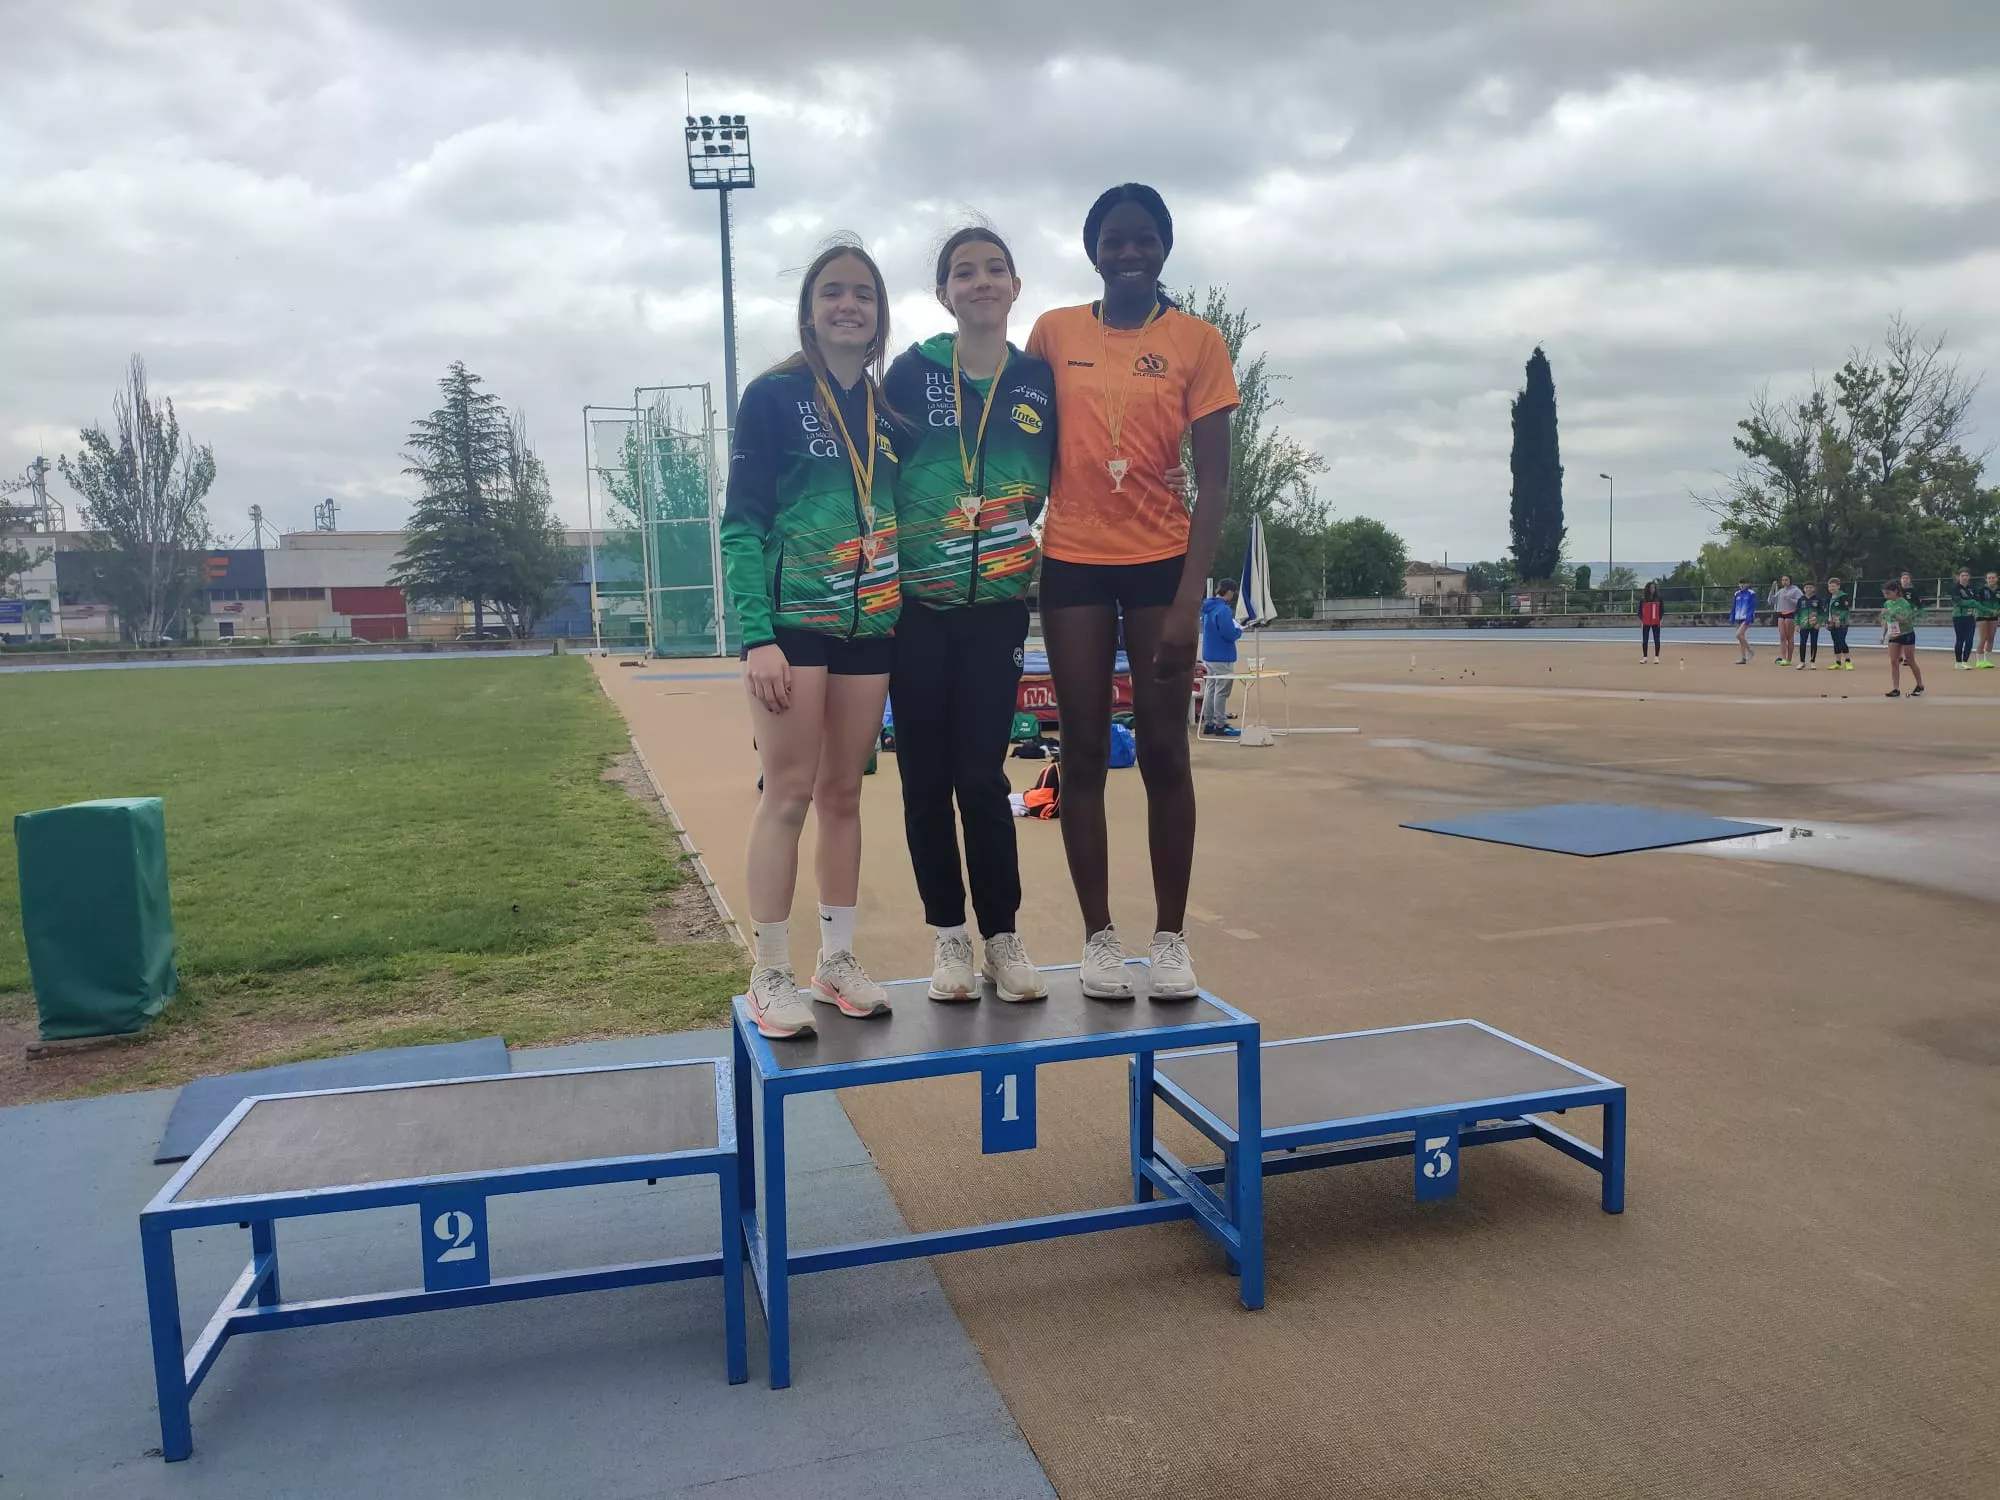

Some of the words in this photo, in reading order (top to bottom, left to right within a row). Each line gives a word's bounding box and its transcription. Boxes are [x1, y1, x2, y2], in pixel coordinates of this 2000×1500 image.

[809, 438, 840, 458] ca
[995, 1074, 1020, 1121] 1
[1423, 1136, 1452, 1178] 3
[433, 1211, 476, 1263] 2
